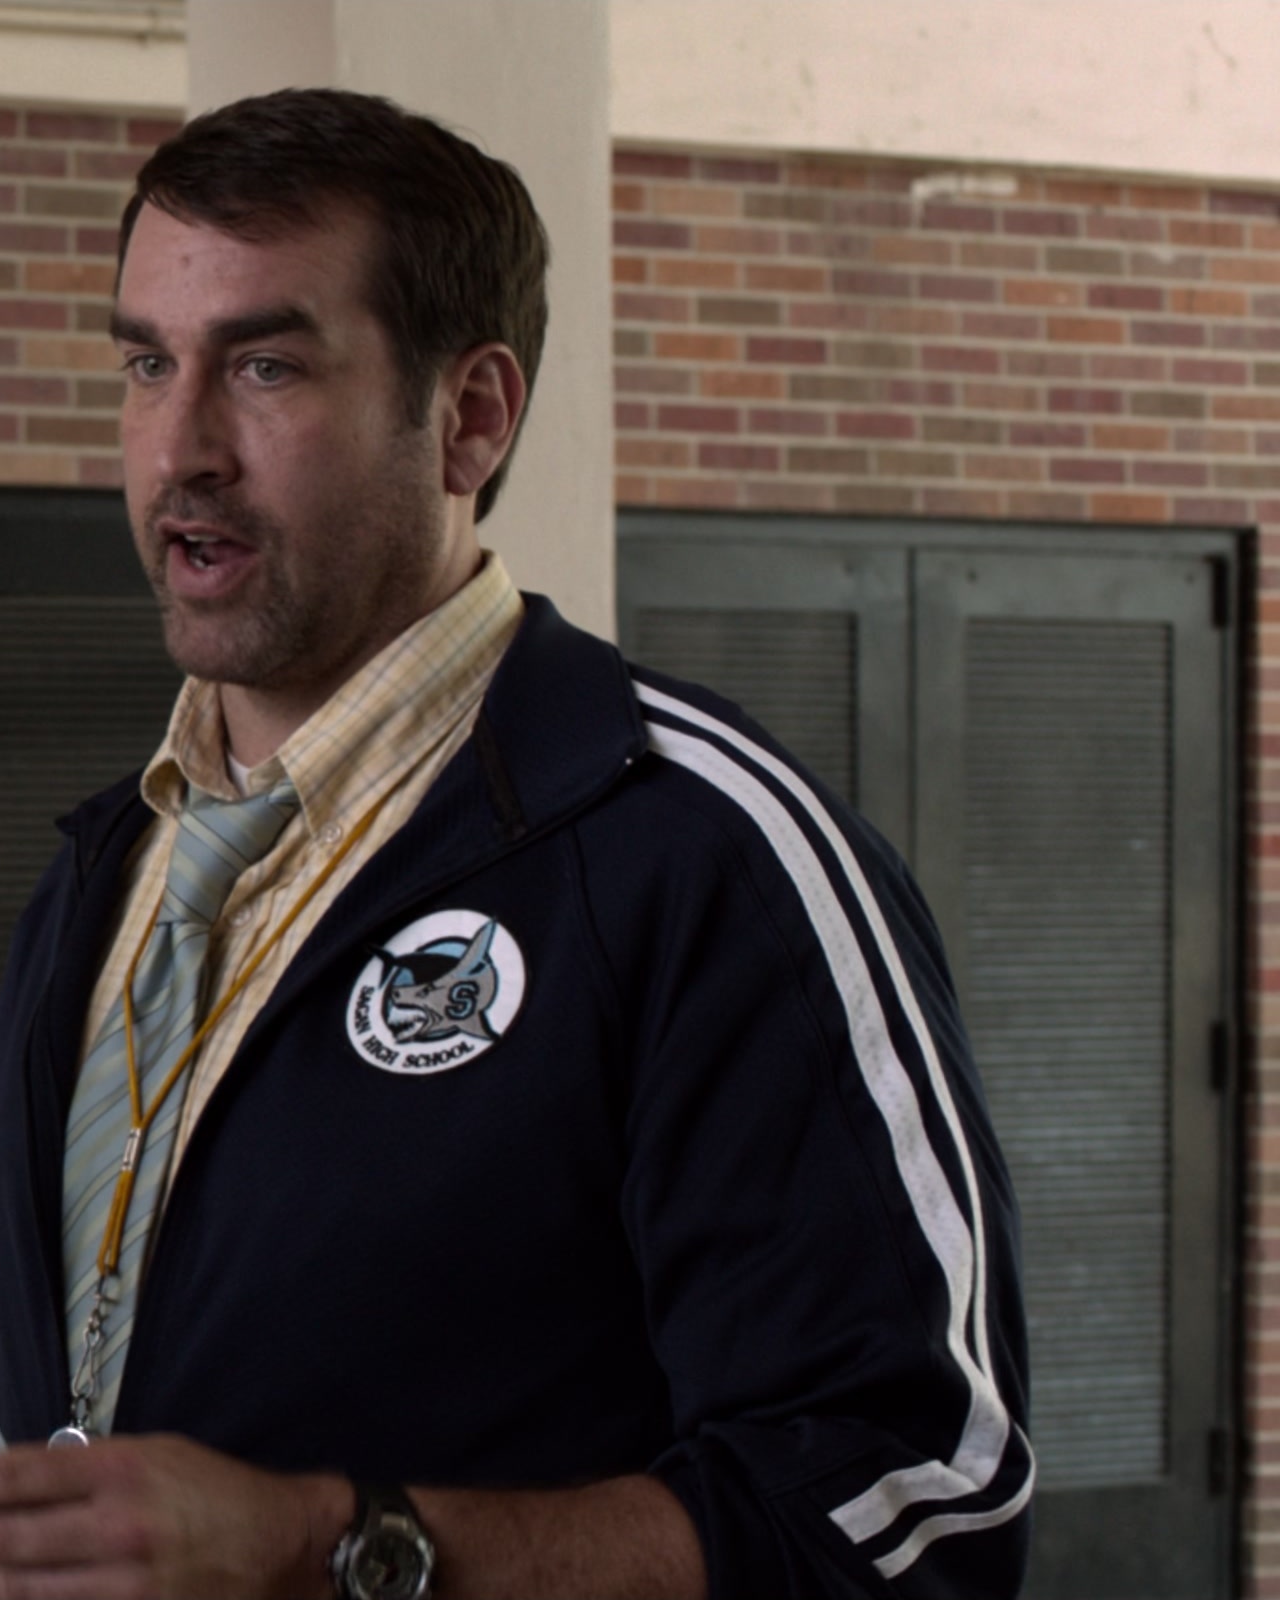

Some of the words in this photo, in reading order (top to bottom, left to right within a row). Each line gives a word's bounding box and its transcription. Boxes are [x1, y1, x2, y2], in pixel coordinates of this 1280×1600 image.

[445, 981, 479, 1019] S
[362, 1035, 399, 1065] HIGH
[403, 1042, 474, 1067] SCHOOL
